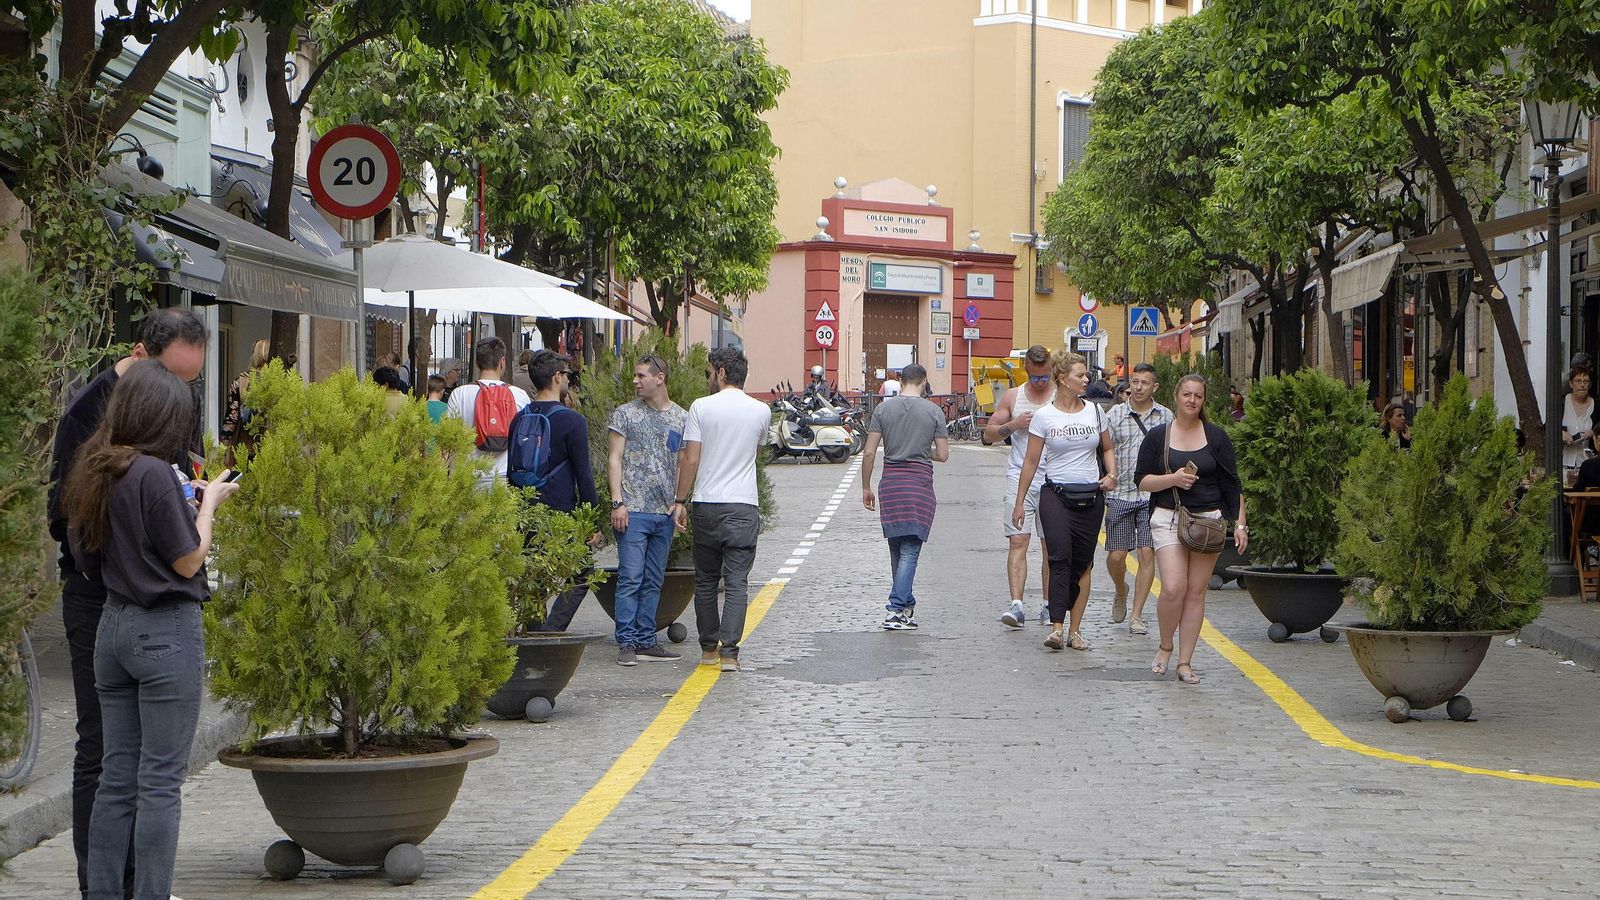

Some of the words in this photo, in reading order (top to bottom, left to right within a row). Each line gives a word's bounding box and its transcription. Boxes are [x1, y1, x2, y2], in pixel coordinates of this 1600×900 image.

[333, 156, 376, 186] 20
[866, 214, 894, 223] COLEGIO
[898, 216, 926, 225] PUBLICO
[874, 225, 888, 233] SAN
[892, 227, 918, 235] ISIDORO
[845, 266, 859, 274] DEL
[818, 330, 832, 340] 30
[1050, 425, 1097, 438] Desmadr
